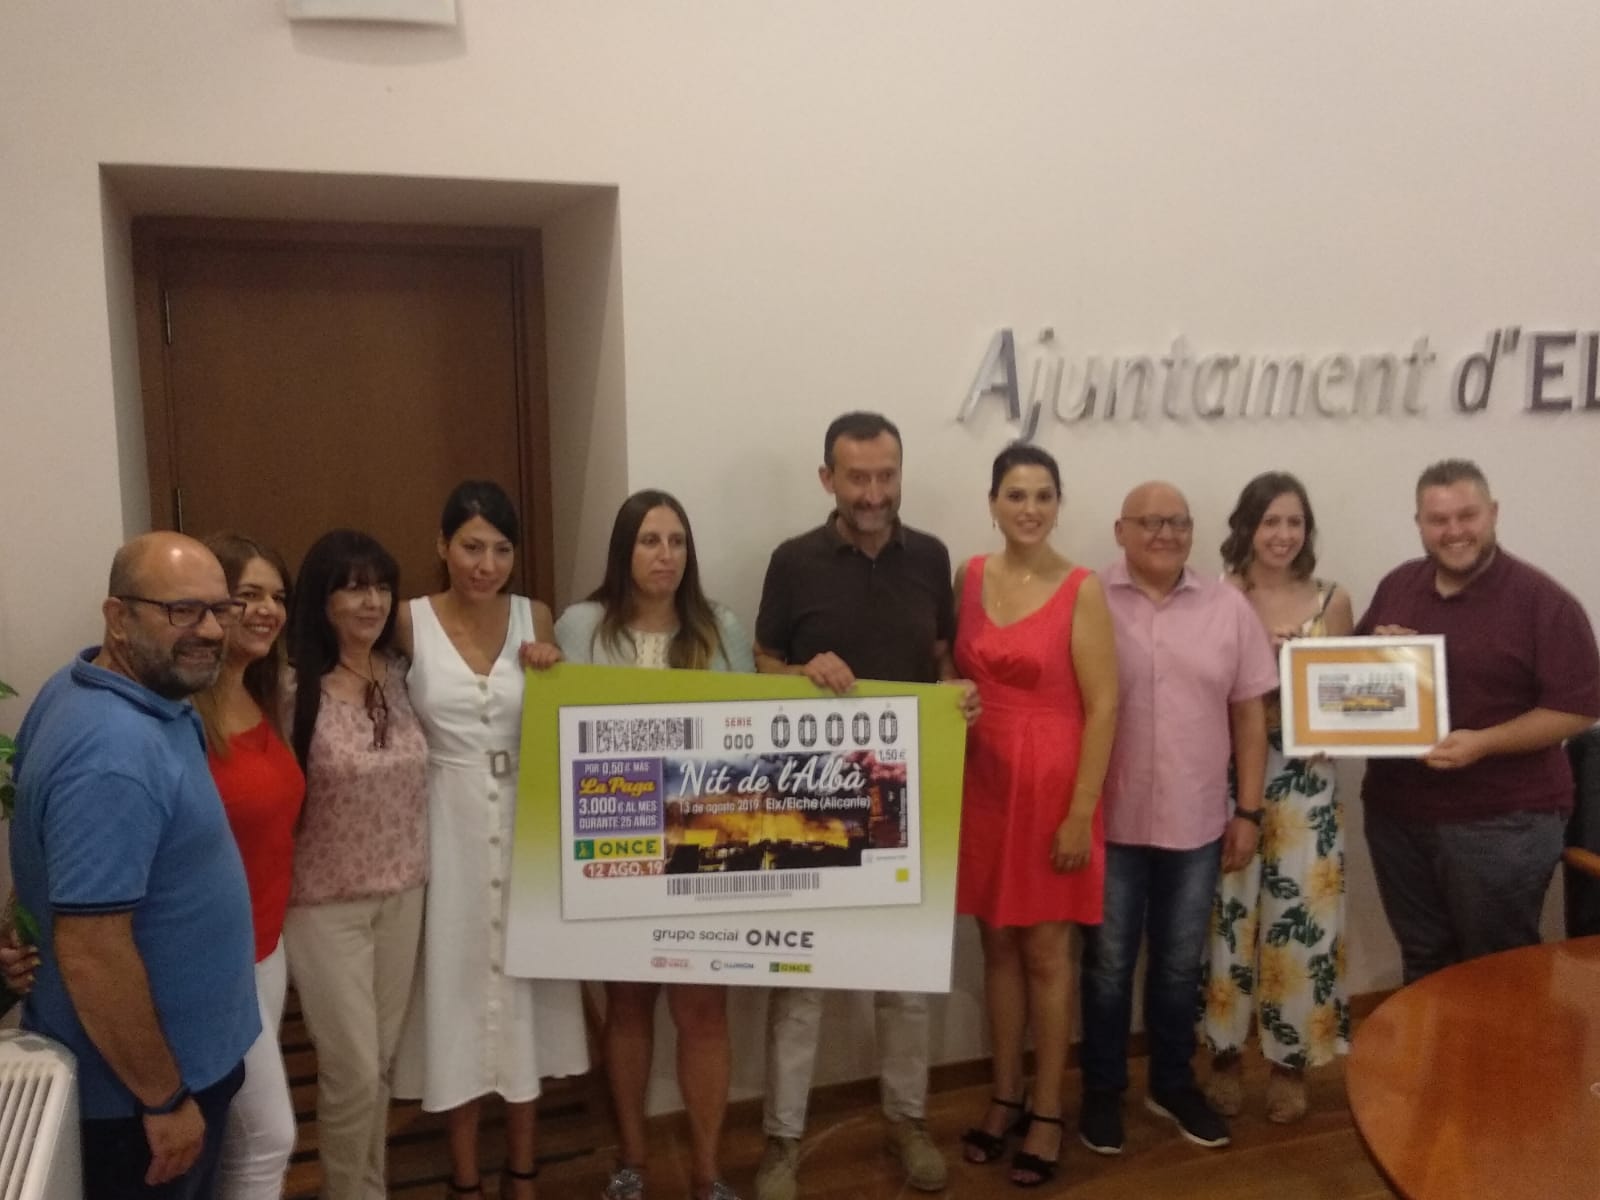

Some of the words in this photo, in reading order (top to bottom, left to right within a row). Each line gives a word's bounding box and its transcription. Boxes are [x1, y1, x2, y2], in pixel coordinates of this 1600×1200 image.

[957, 329, 1433, 441] Ajuntament
[723, 733, 754, 750] 000
[584, 763, 600, 774] POR
[602, 761, 623, 776] 0,50
[680, 759, 731, 798] Nit
[738, 763, 770, 793] de
[578, 776, 608, 796] La
[608, 775, 656, 798] Paga
[578, 796, 617, 816] 3.000
[625, 801, 637, 813] AL
[638, 800, 657, 813] MES
[692, 802, 704, 813] de
[705, 800, 735, 816] agosto
[737, 799, 760, 812] 2019
[819, 795, 871, 811] (Alicante)
[578, 815, 619, 829] DURANTE
[620, 815, 632, 827] 25
[633, 813, 657, 827] AÑOS
[599, 839, 658, 856] ONCE
[587, 863, 603, 878] 12
[648, 861, 662, 875] 19
[652, 927, 696, 942] grupo
[699, 928, 738, 942] social
[746, 928, 815, 949] ONCE
